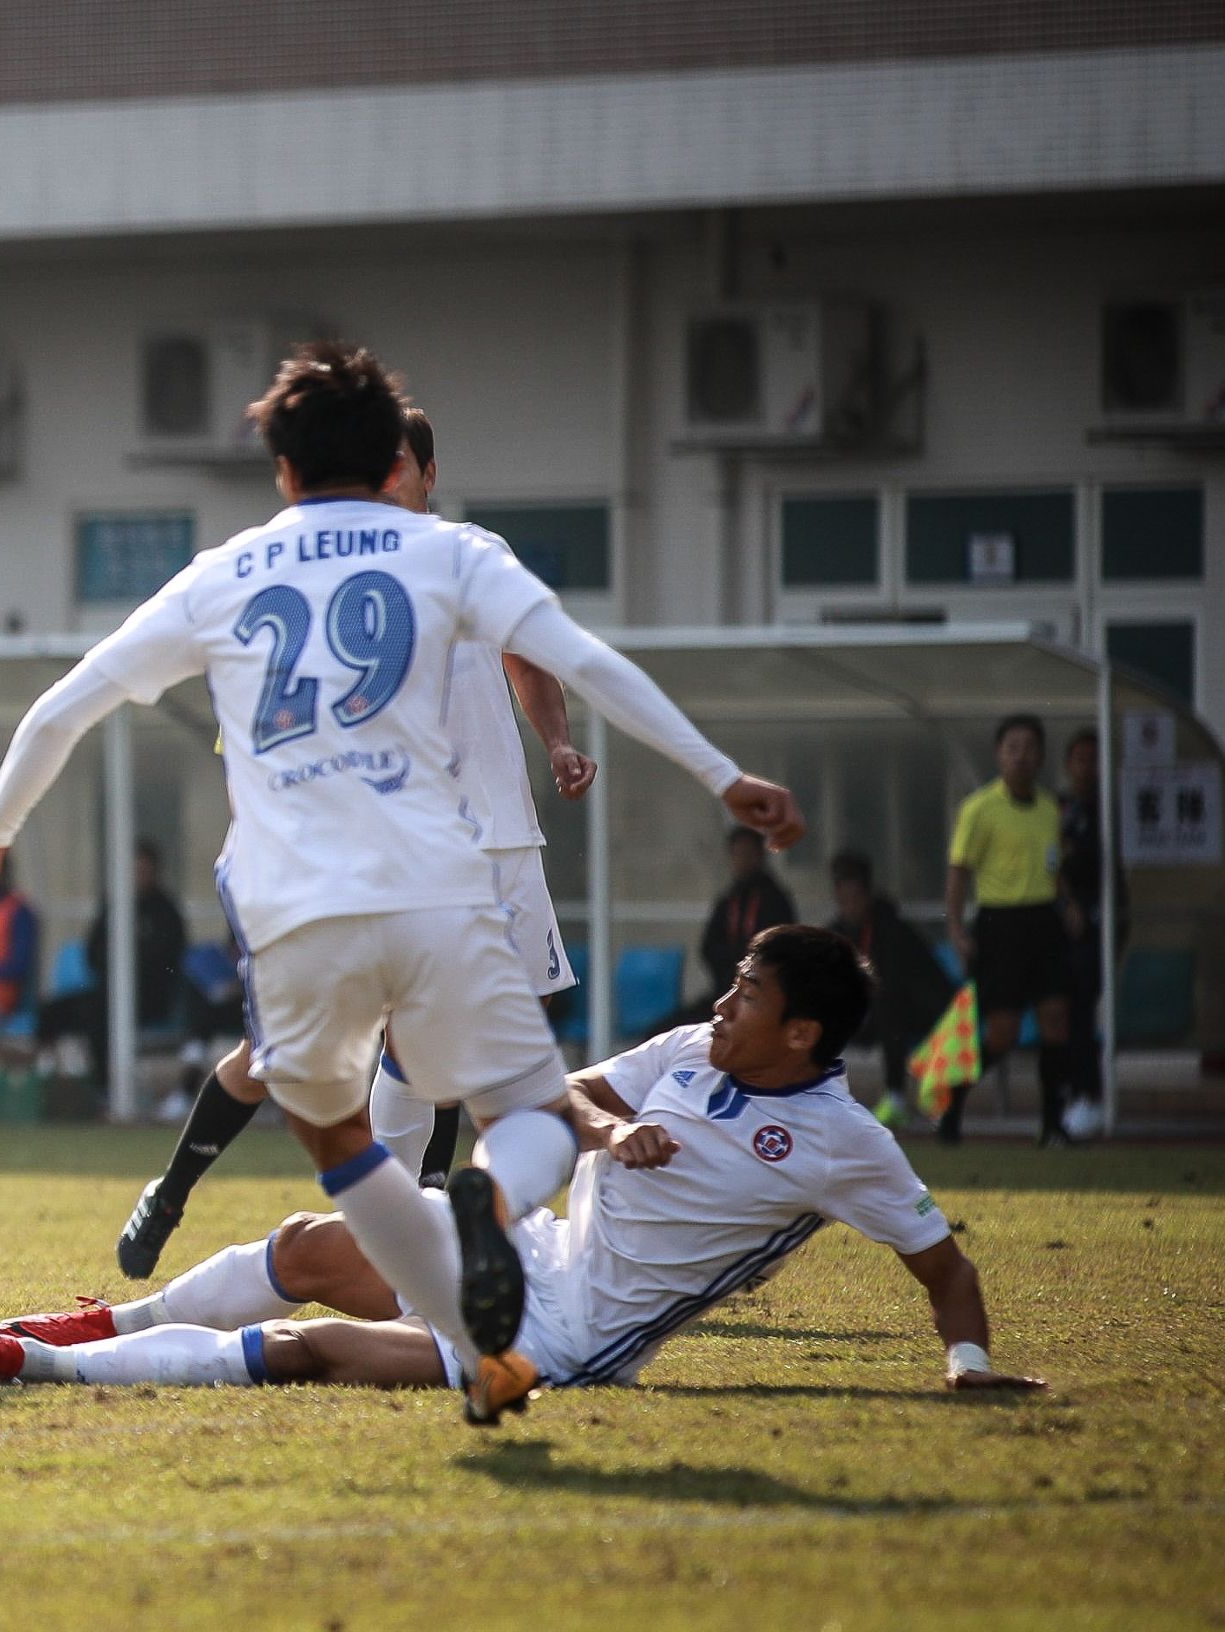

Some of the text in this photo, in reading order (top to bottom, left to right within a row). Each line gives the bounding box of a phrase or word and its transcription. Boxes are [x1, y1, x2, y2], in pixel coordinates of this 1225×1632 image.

[236, 530, 400, 578] C P LEUNG
[233, 569, 417, 754] 29
